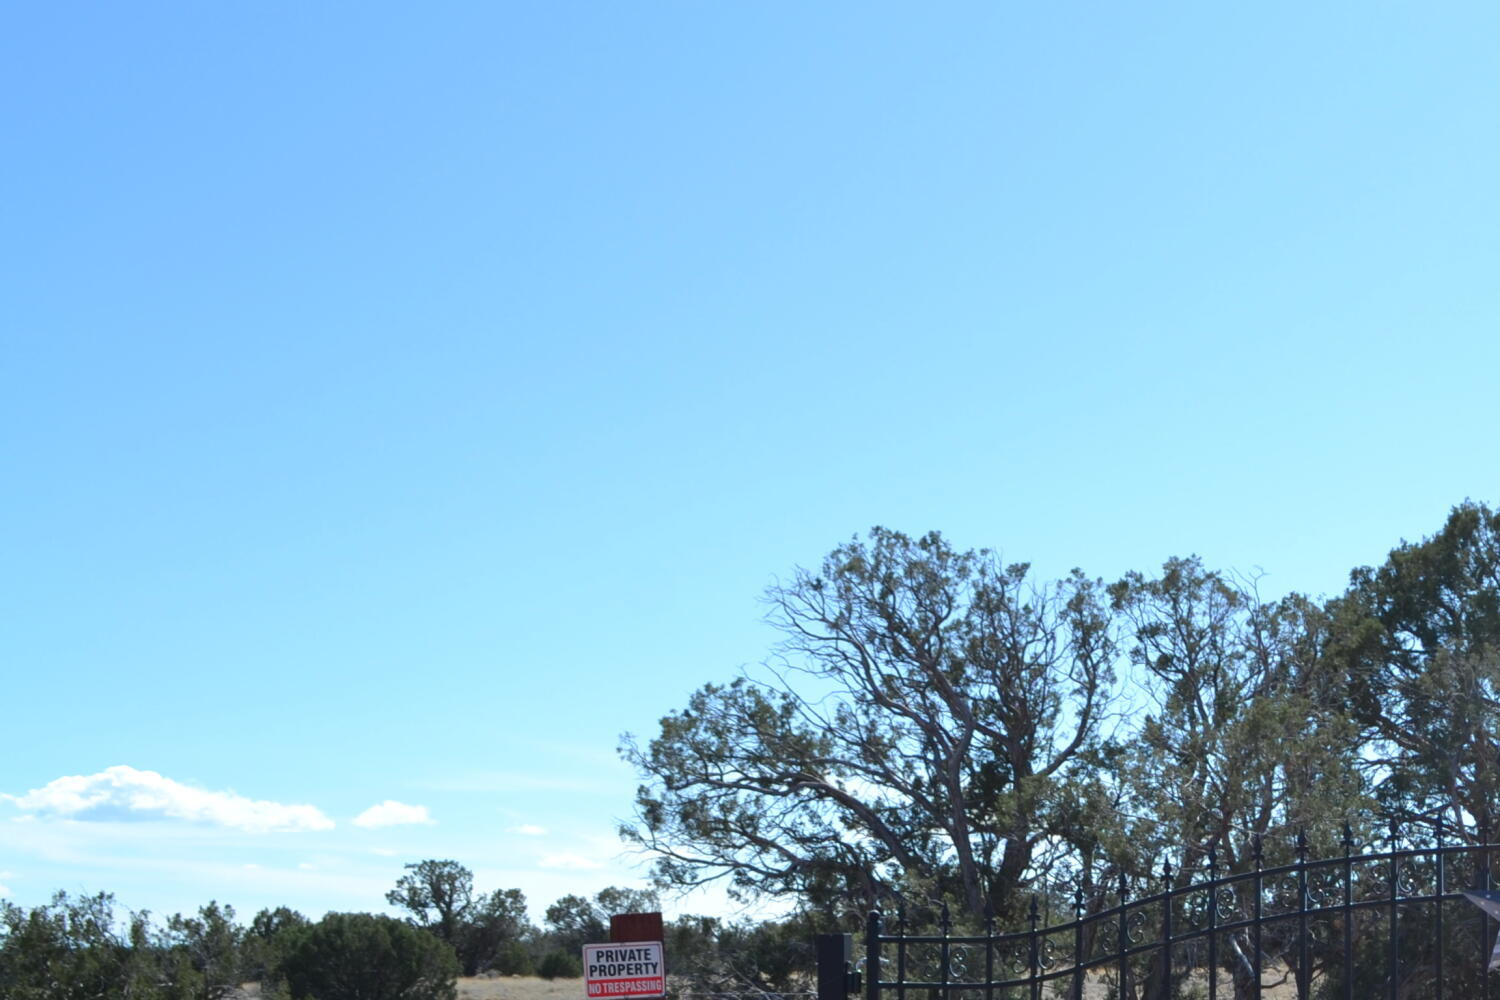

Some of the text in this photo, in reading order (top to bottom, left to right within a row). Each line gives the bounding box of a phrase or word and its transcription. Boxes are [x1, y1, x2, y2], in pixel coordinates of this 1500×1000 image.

[596, 948, 652, 963] PRIVATE
[589, 962, 658, 977] PROPERTY
[589, 979, 662, 994] NO TRESPASSING
